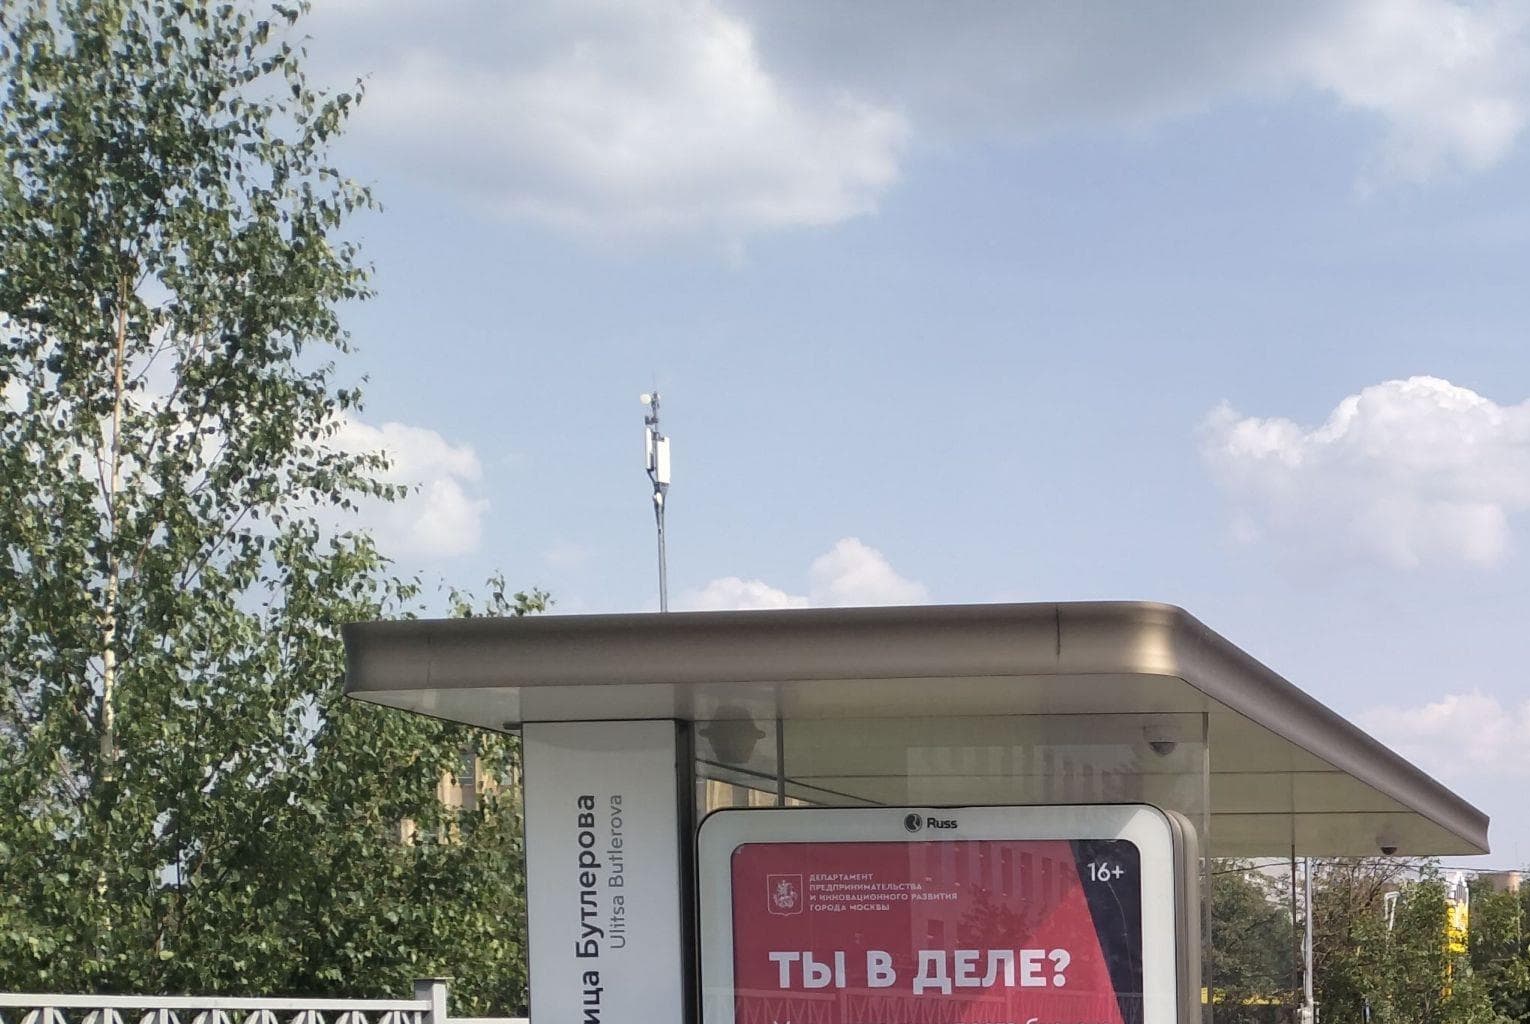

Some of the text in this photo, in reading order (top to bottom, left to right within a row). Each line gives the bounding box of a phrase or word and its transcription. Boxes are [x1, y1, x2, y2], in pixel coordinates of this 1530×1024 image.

[926, 817, 958, 830] Russ
[575, 794, 604, 959] Бутлерова
[607, 793, 626, 949] Ulitsa Butlerova
[809, 873, 873, 882] ДЕПАРТАМЕНТ
[1087, 862, 1125, 882] 16+
[809, 883, 922, 892] ПРЕДПРИНИМАТЕЛЬСТВА
[819, 893, 908, 902] ИННОВАЦИОННОГО
[911, 892, 958, 900] РАЗВИТИЯ
[809, 903, 890, 912] ГОРОДА МОСКВЫ
[769, 948, 1071, 995] ТЫ В ДЕЛЕ?
